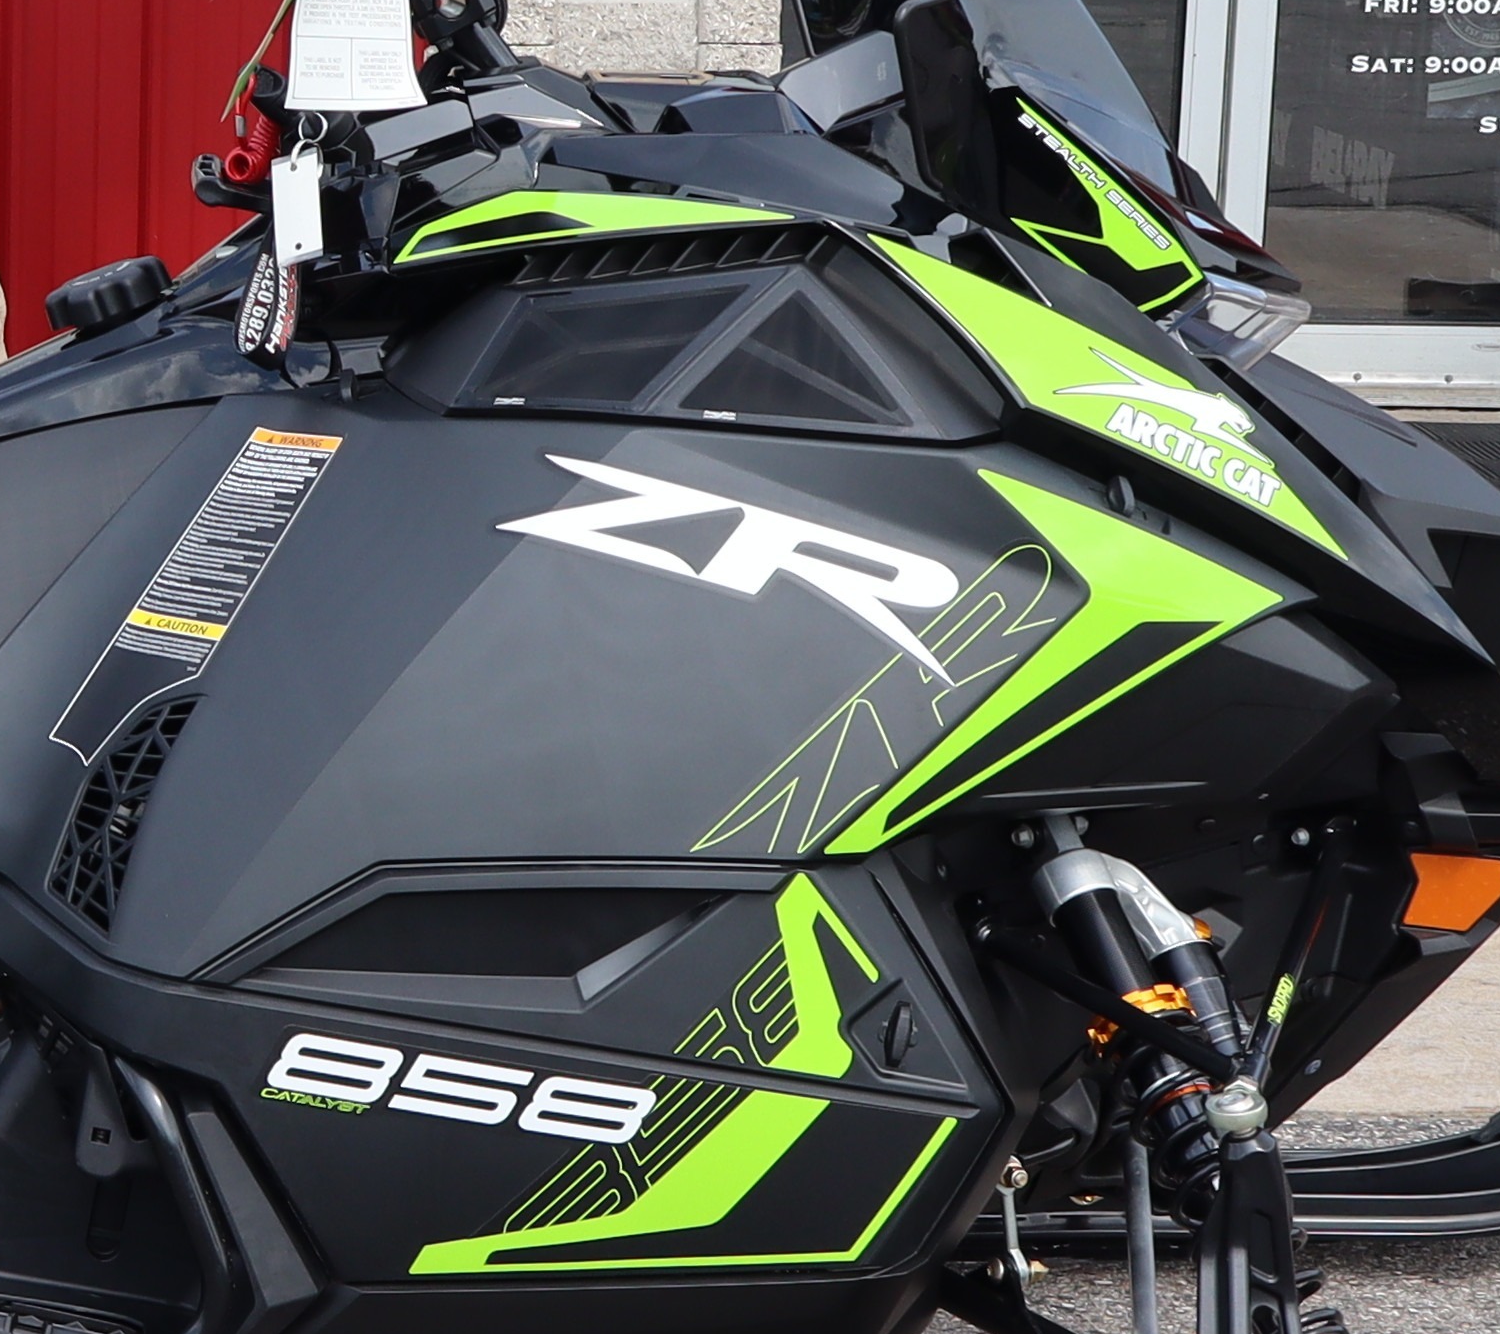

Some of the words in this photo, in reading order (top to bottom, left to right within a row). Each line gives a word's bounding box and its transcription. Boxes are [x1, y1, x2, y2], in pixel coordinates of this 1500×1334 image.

[1017, 112, 1108, 190] STEALTH
[1104, 188, 1173, 251] SERIES
[279, 436, 324, 448] WARNING
[1105, 402, 1223, 479] ARCTIC
[1221, 458, 1282, 507] CAT
[496, 453, 962, 688] ZR
[156, 618, 209, 635] CAUTION
[260, 1087, 371, 1115] CATALYST
[265, 1032, 659, 1145] 858
